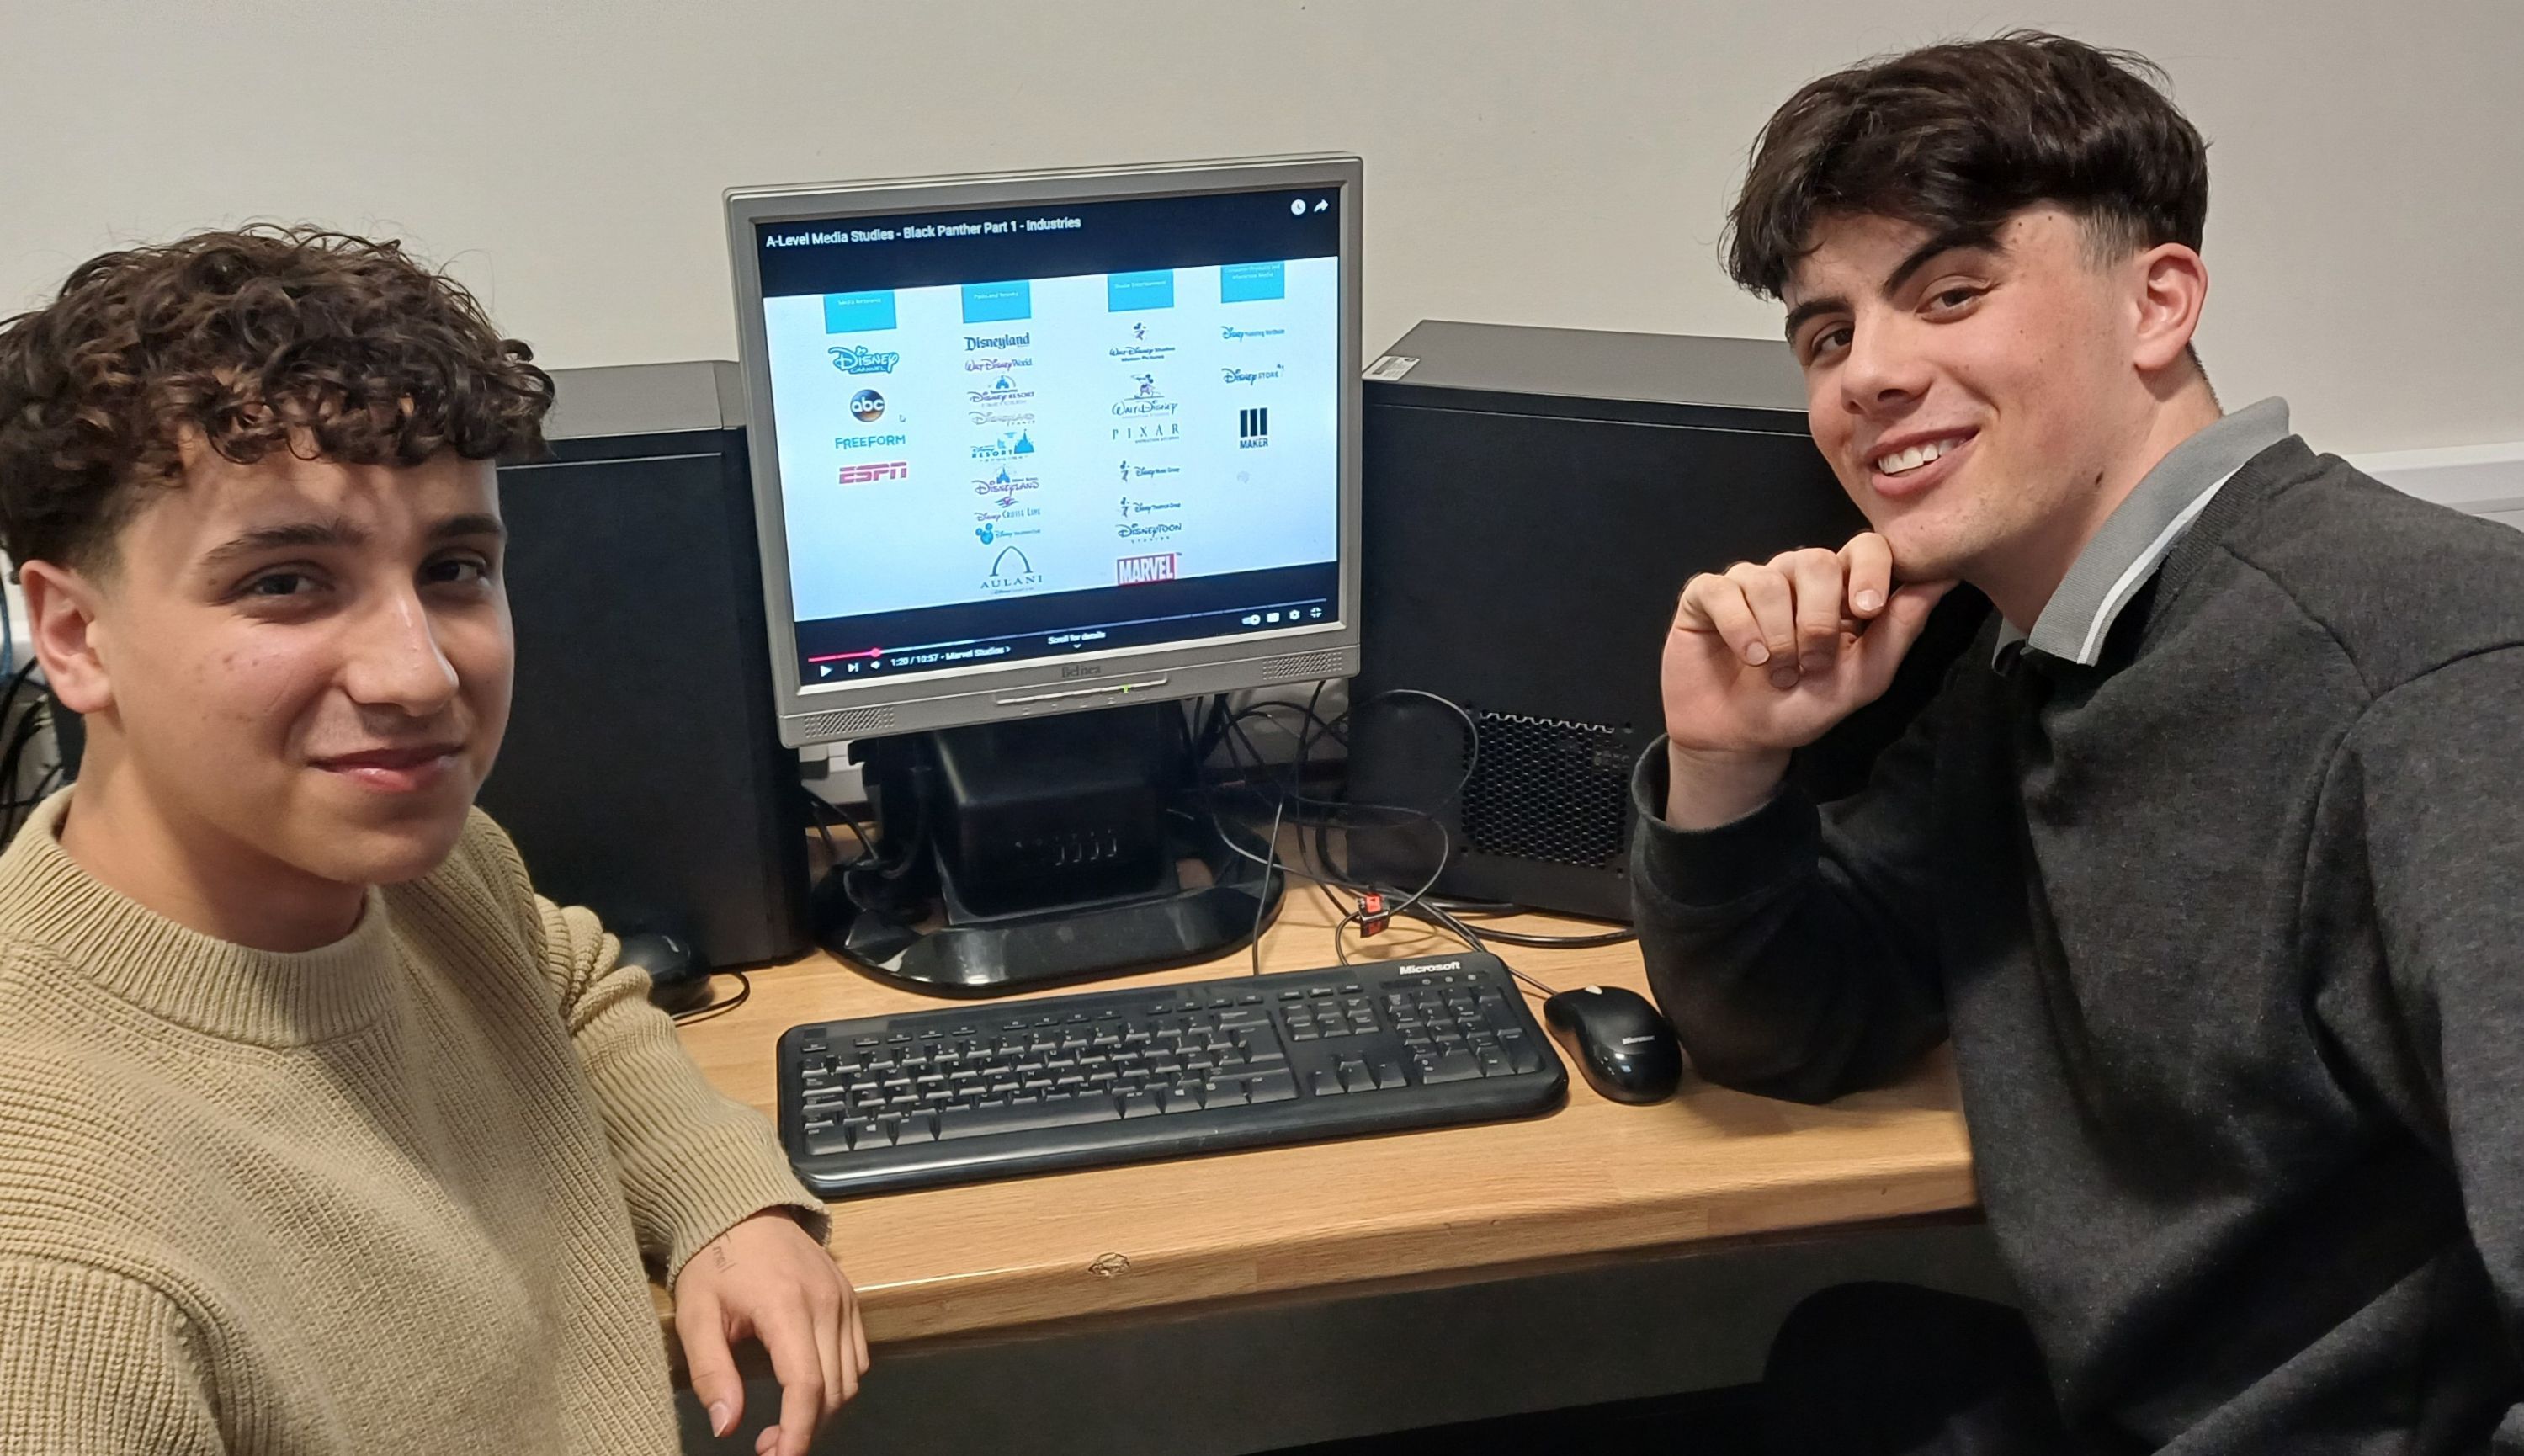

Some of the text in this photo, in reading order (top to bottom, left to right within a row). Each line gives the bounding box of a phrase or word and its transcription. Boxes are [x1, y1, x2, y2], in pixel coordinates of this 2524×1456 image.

[766, 231, 810, 247] A-Level
[812, 230, 848, 246] Media
[851, 227, 894, 243] Studies
[903, 225, 935, 239] Black
[938, 221, 981, 237] Panther
[984, 221, 1008, 235] Part
[1010, 221, 1016, 232] 1
[1026, 216, 1081, 231] Industries
[964, 332, 1030, 352] Disneyland
[851, 396, 884, 412] abc
[1113, 423, 1179, 440] PIXAR
[835, 435, 906, 449] FREEFORM
[1240, 438, 1268, 449] MAKER
[839, 462, 906, 485] ESPN
[1118, 555, 1175, 585] MARVEL
[980, 575, 1043, 589] AULANI
[1048, 635, 1070, 645] Scroll
[890, 656, 909, 667] 1:20
[916, 653, 939, 663] 10:57
[1399, 961, 1461, 975] Microsoft
